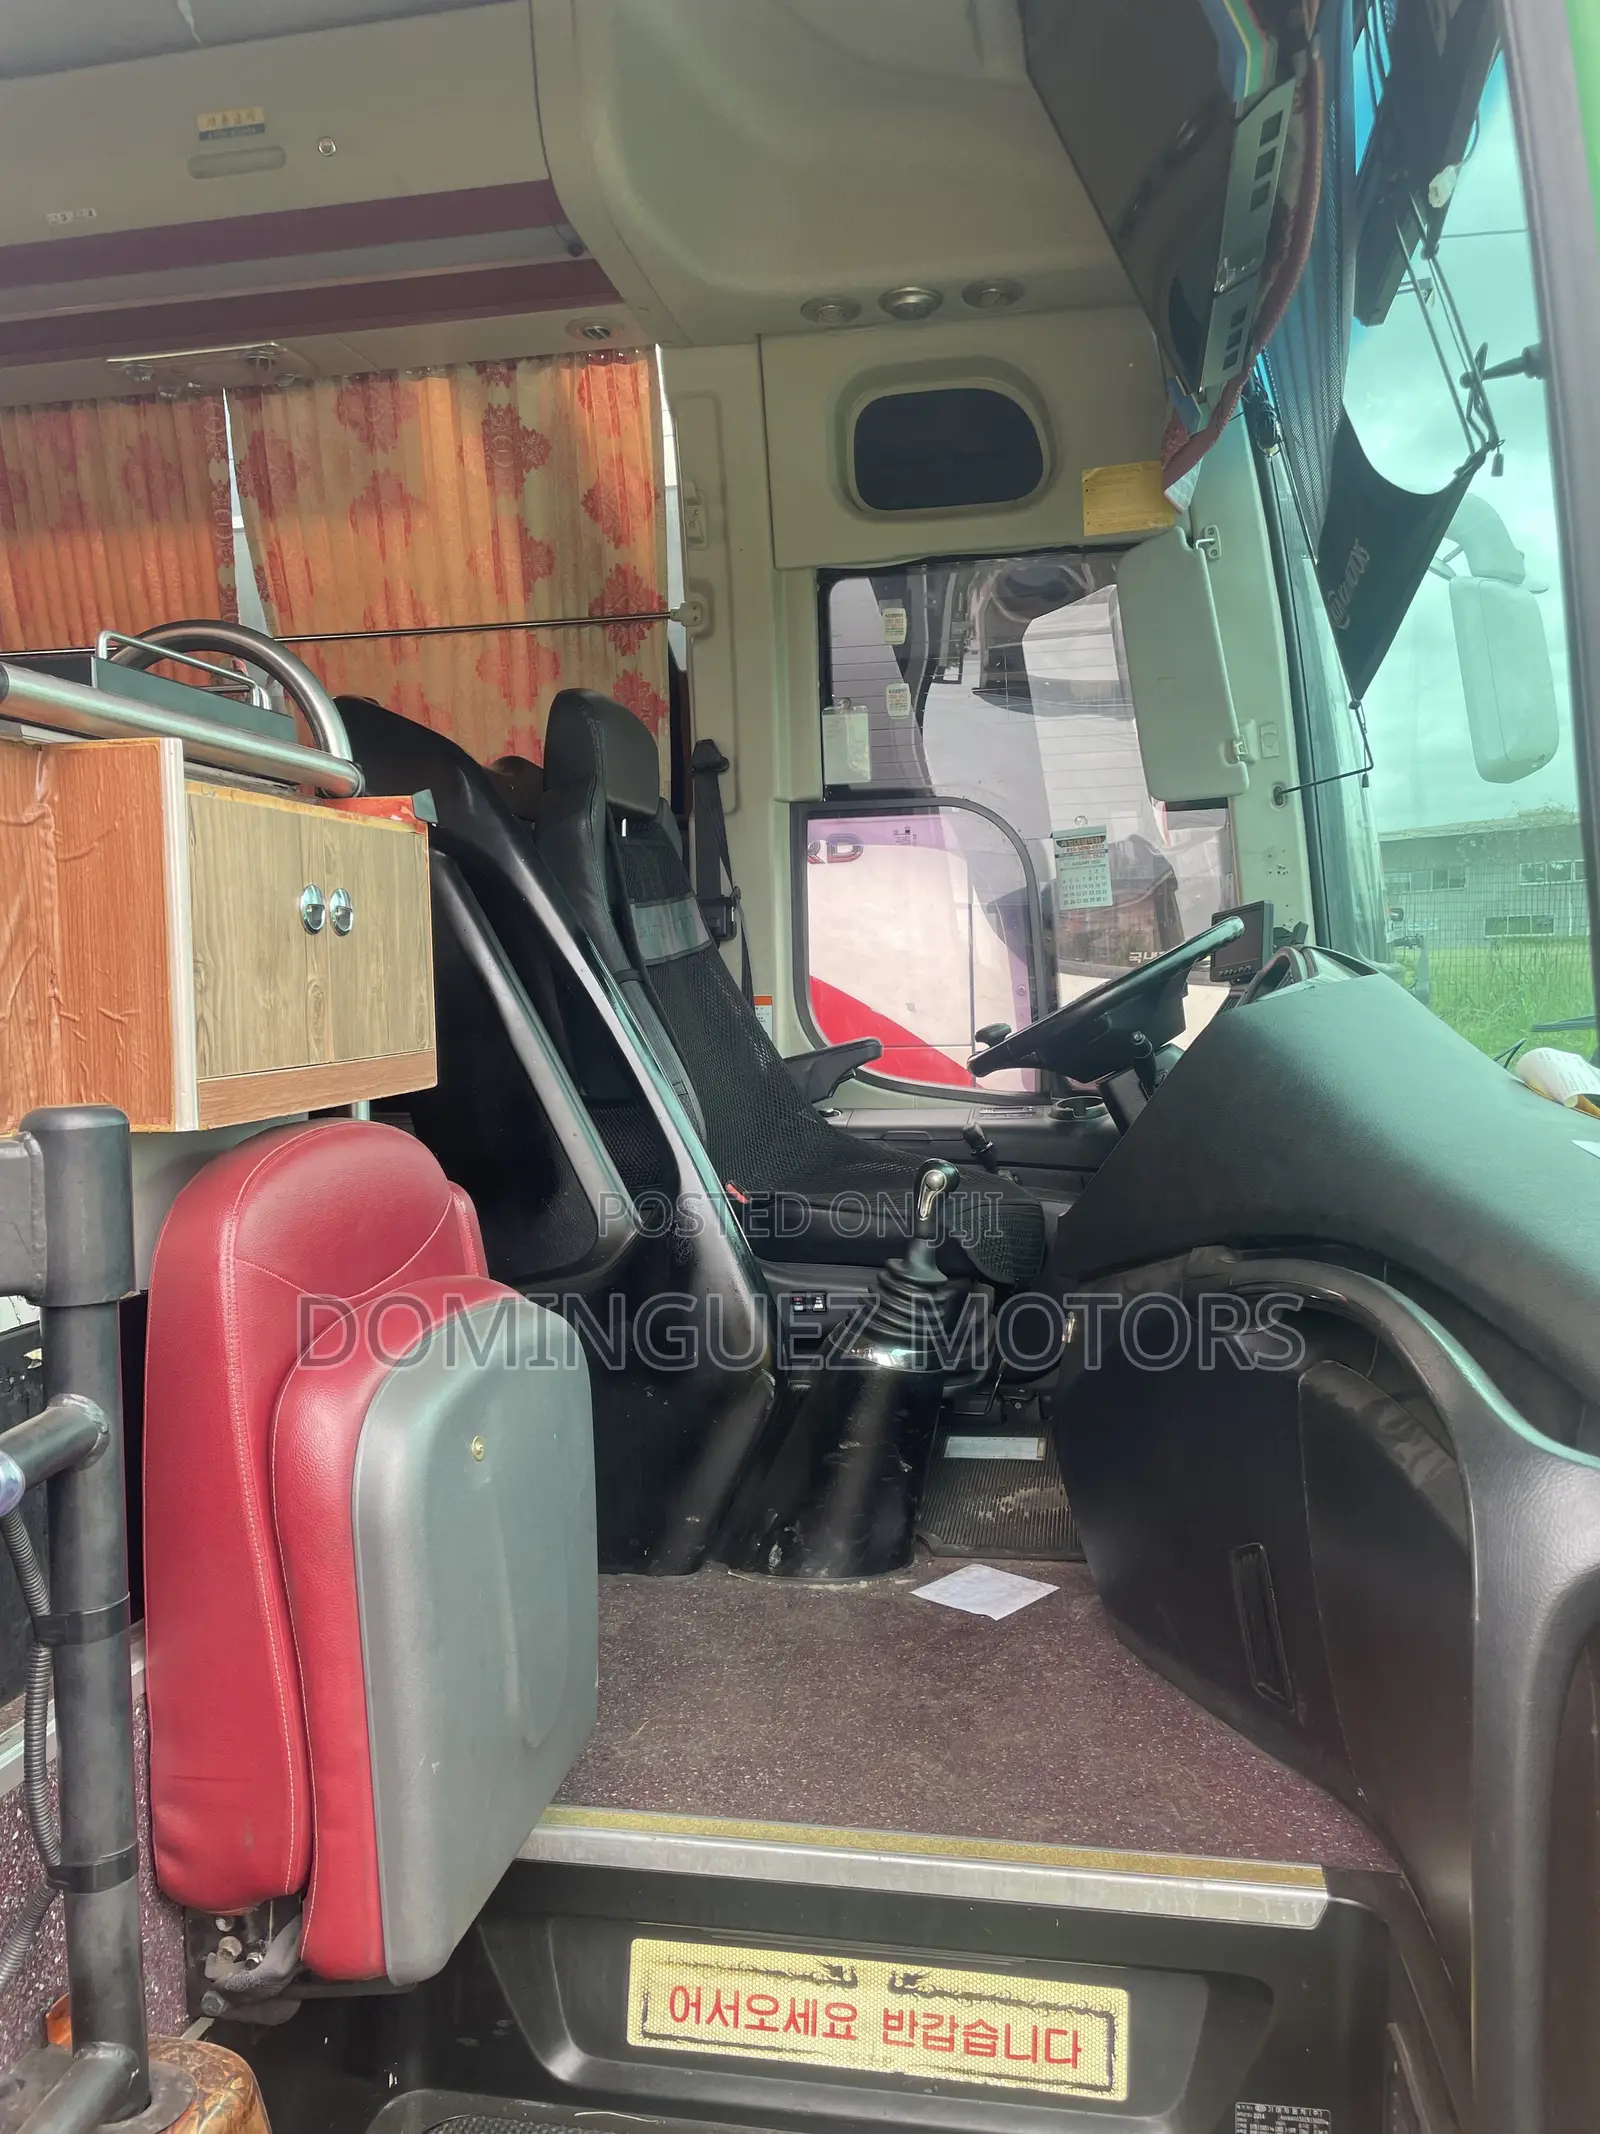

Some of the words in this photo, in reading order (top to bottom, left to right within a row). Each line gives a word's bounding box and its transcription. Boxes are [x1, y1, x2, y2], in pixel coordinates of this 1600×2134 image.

[1129, 951, 1165, 963] 국내
[668, 1985, 857, 2042] 어서오세요
[882, 2007, 1082, 2069] 반갑습니다
